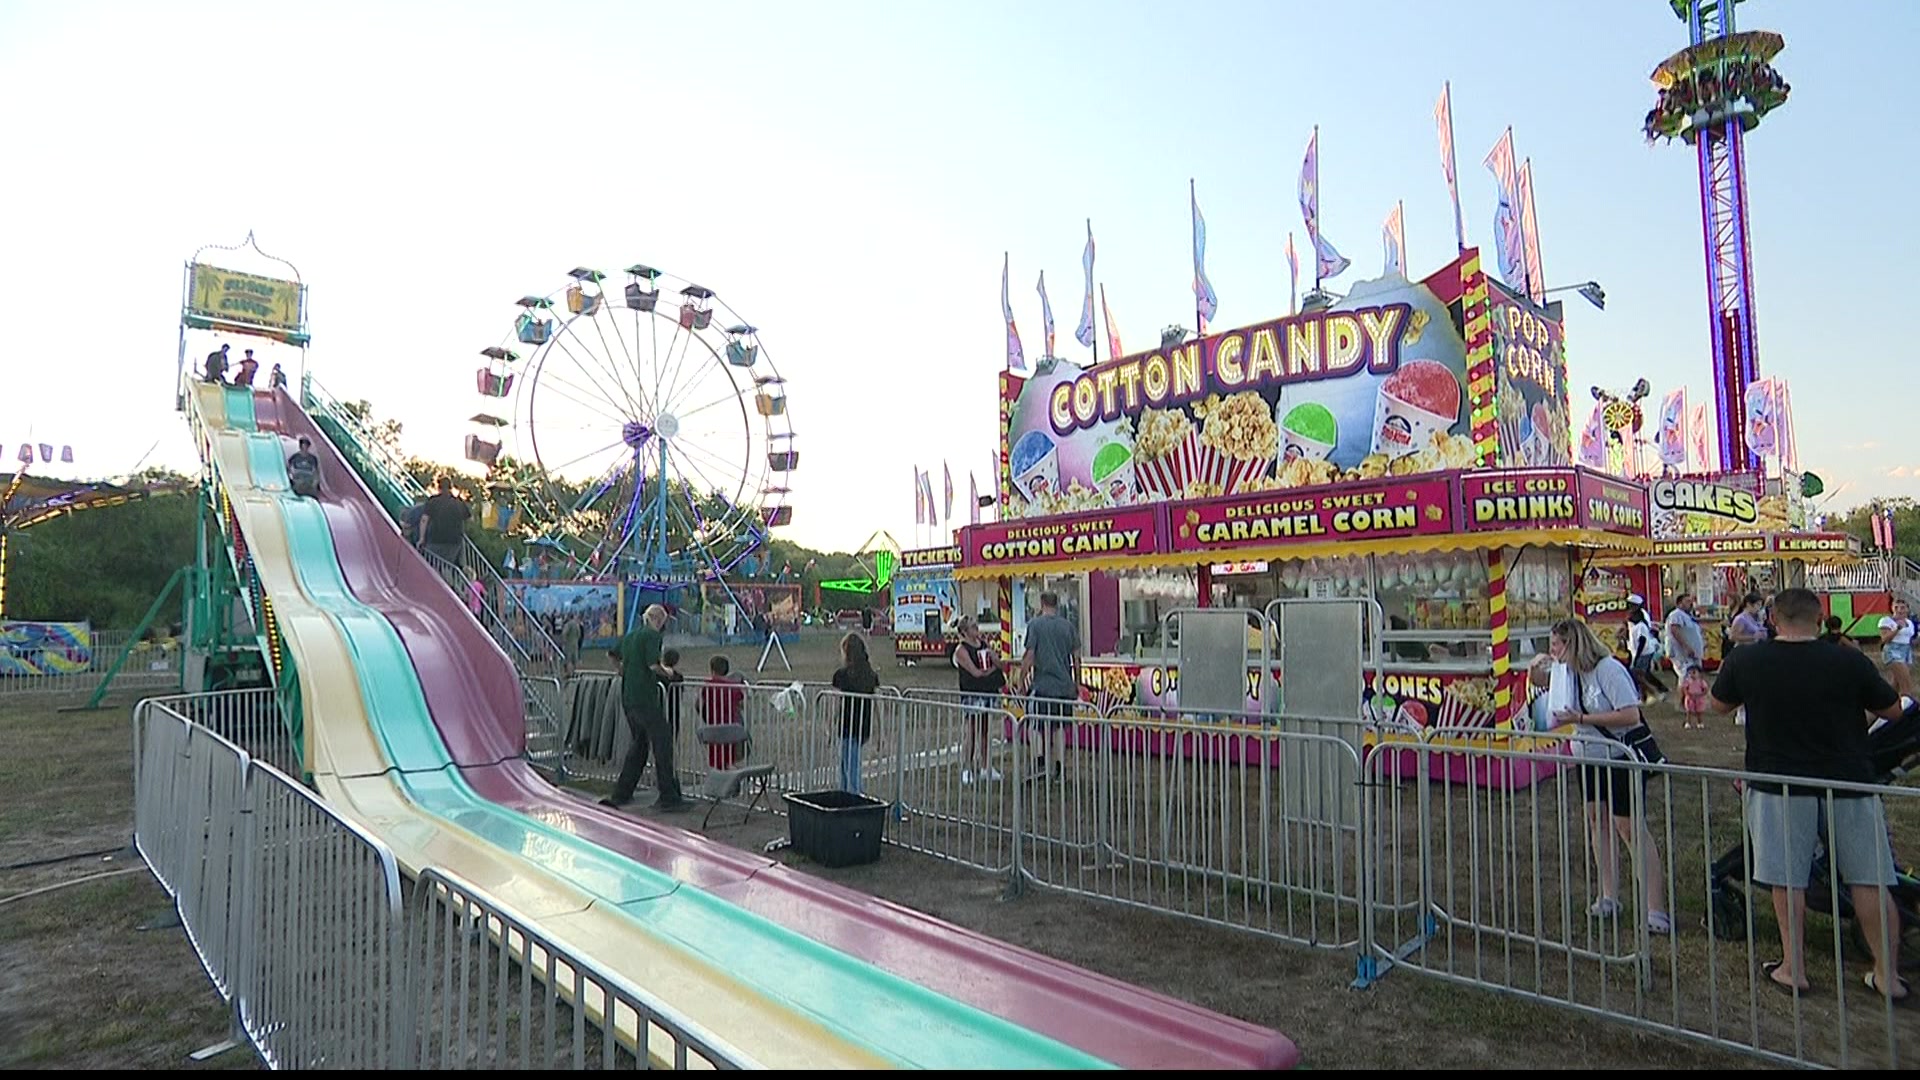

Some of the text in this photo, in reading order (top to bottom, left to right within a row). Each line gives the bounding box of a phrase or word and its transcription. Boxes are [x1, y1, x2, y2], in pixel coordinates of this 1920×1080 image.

[1508, 306, 1549, 351] POP
[1051, 307, 1403, 432] COTTON CANDY
[1506, 343, 1555, 398] CORN
[1483, 478, 1567, 494] ICE COLD
[1226, 492, 1386, 518] DELICIOUS SWEET
[1475, 495, 1574, 521] DRINKS
[1588, 498, 1643, 529] SNO CONES
[1655, 481, 1757, 522] CAKES
[1007, 519, 1114, 539] DELICIOUS SWEET
[1196, 506, 1417, 542] CARAMEL CORN
[982, 530, 1140, 560] COTTON CANDY
[1654, 539, 1764, 553] FUNNEL CAKES
[660, 573, 698, 583] WHEEL
[1587, 600, 1627, 615] FOOD
